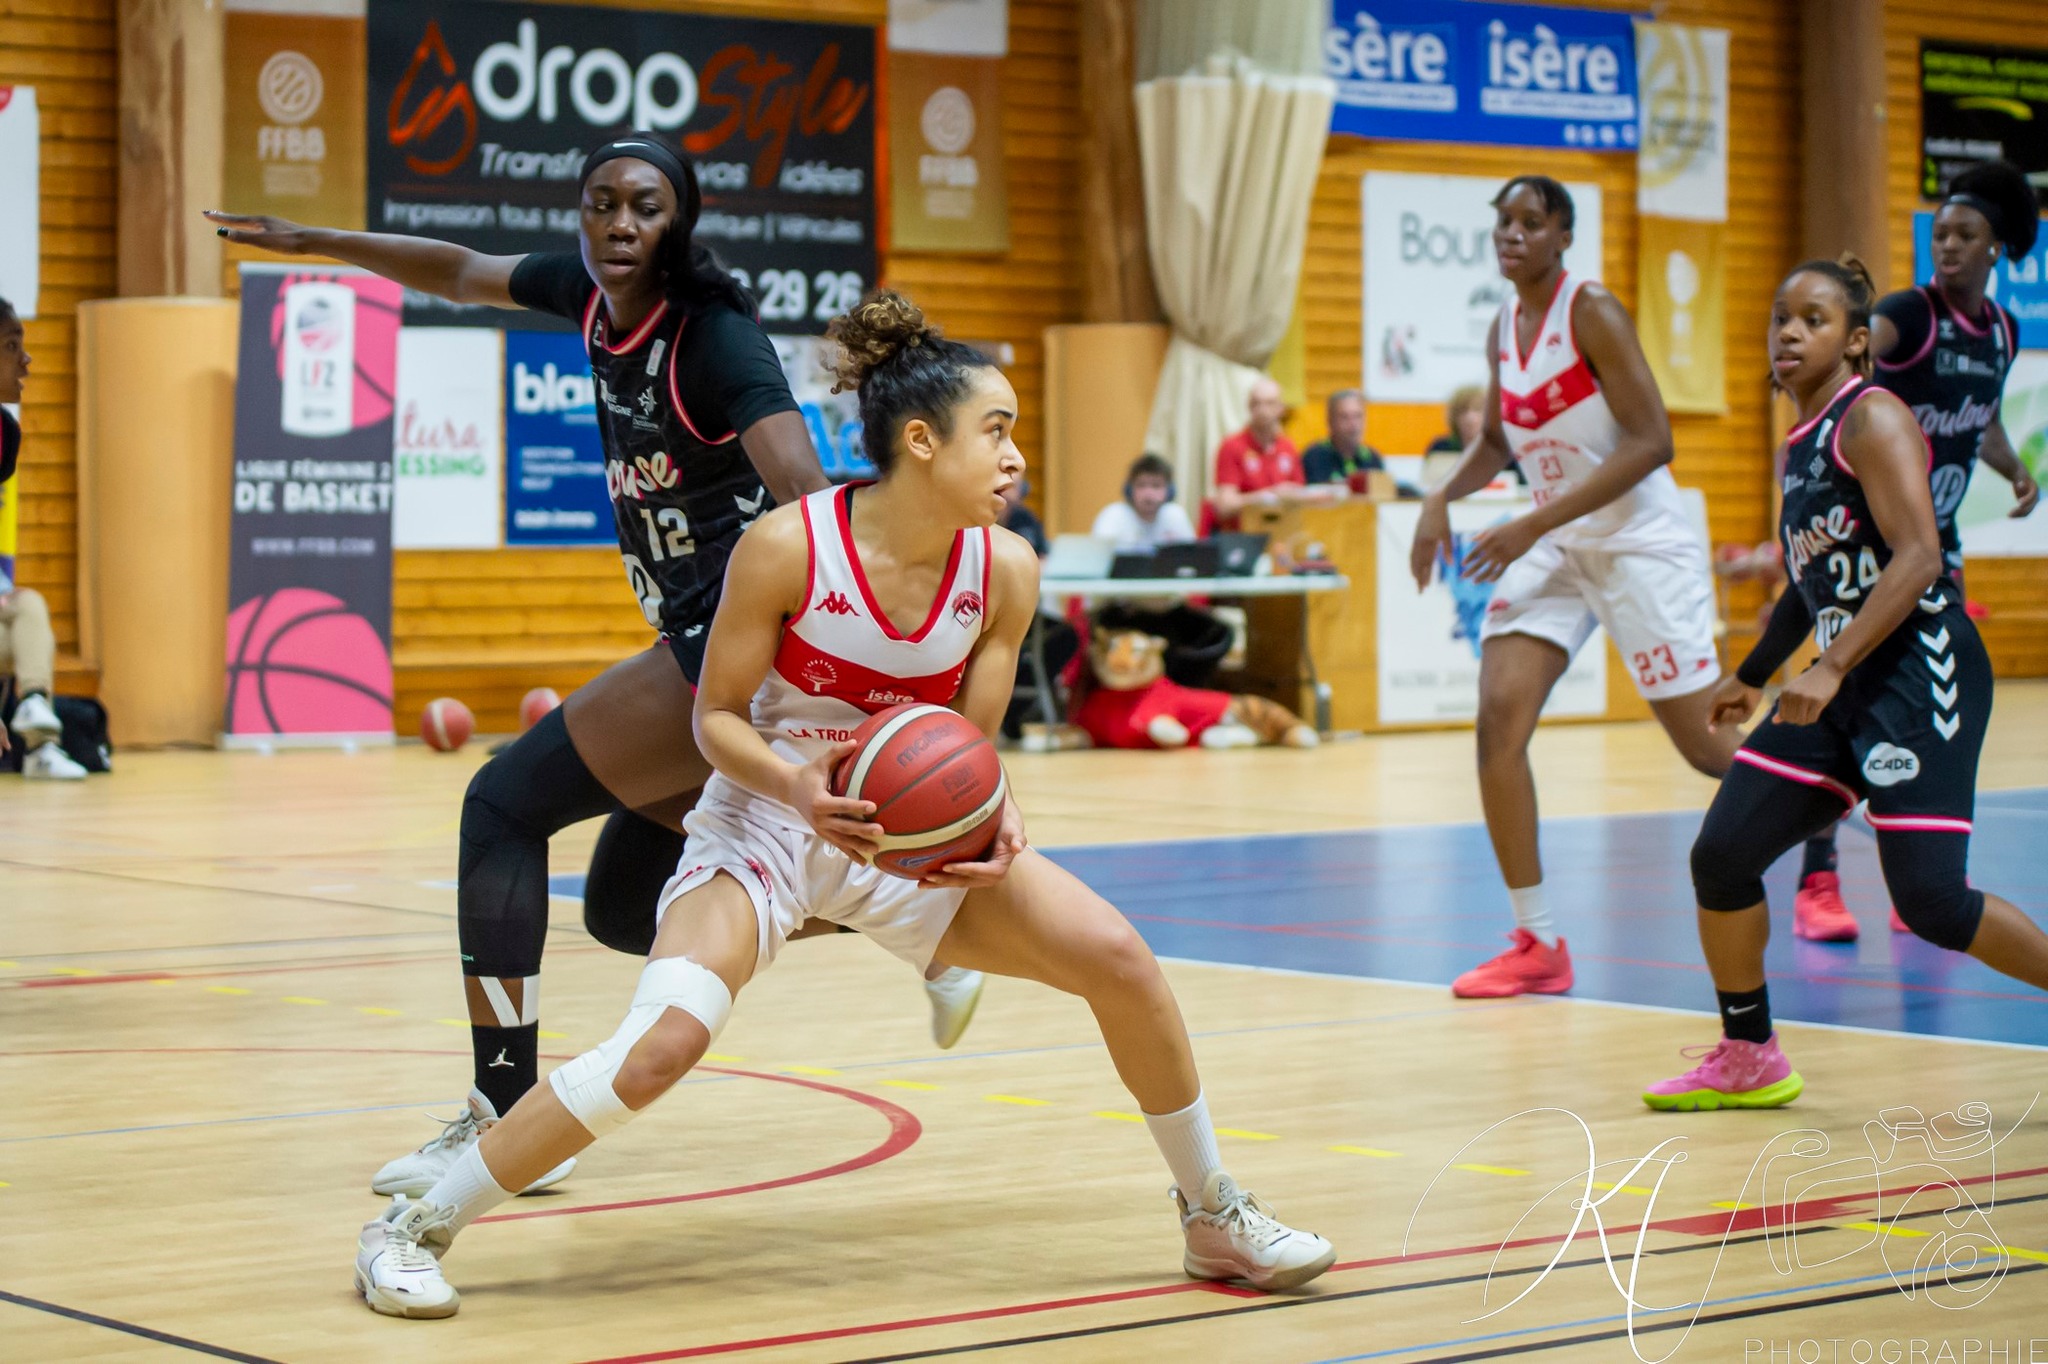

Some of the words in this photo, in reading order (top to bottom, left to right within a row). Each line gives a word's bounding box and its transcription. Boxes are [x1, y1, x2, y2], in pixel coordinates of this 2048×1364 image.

[472, 17, 698, 134] drop
[1488, 19, 1619, 93] isère
[257, 127, 326, 161] FFBB
[758, 269, 808, 319] 29
[814, 271, 862, 320] 26
[234, 480, 275, 514] DE
[282, 481, 391, 516] BASKET
[640, 507, 695, 562] 12
[1828, 545, 1883, 601] 24
[1633, 643, 1681, 688] 23
[867, 688, 915, 704] isère
[788, 728, 812, 739] LA
[814, 728, 853, 743] TRO
[1867, 758, 1914, 771] ICADE
